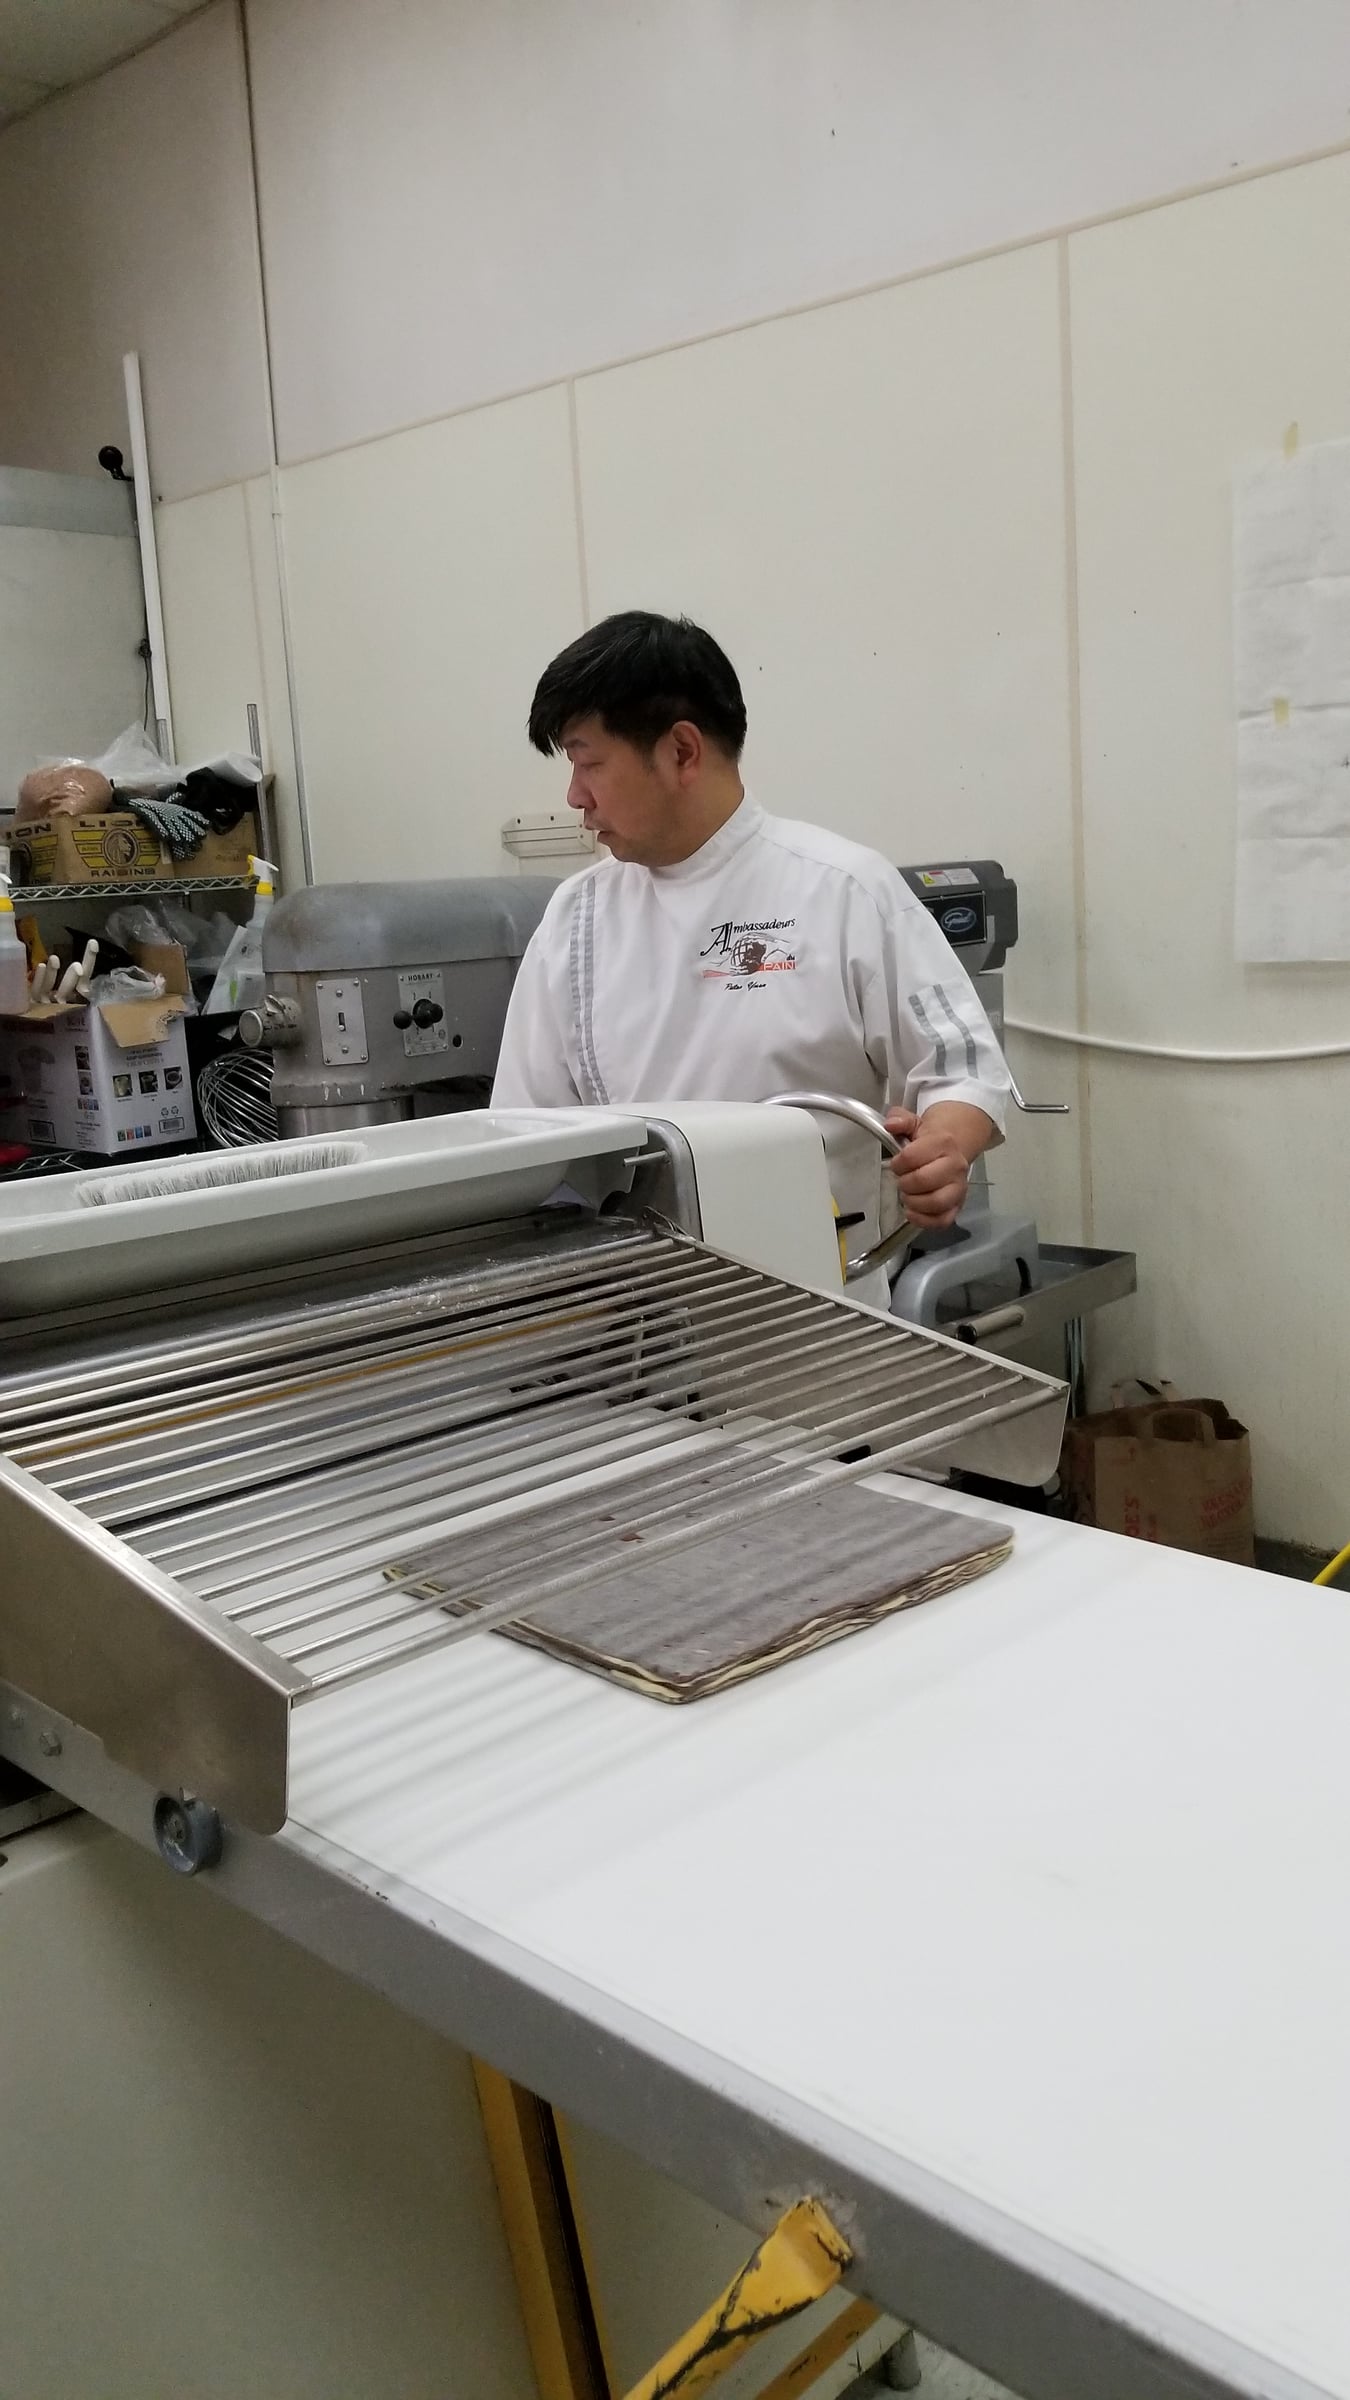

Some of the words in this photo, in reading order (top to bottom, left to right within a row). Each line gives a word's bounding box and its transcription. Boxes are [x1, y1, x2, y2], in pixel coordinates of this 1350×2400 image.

[6, 823, 52, 839] ION
[91, 867, 156, 878] RAISINS
[700, 919, 796, 956] Ambassadeurs
[763, 961, 796, 971] PAIN
[408, 973, 433, 982] HOBART
